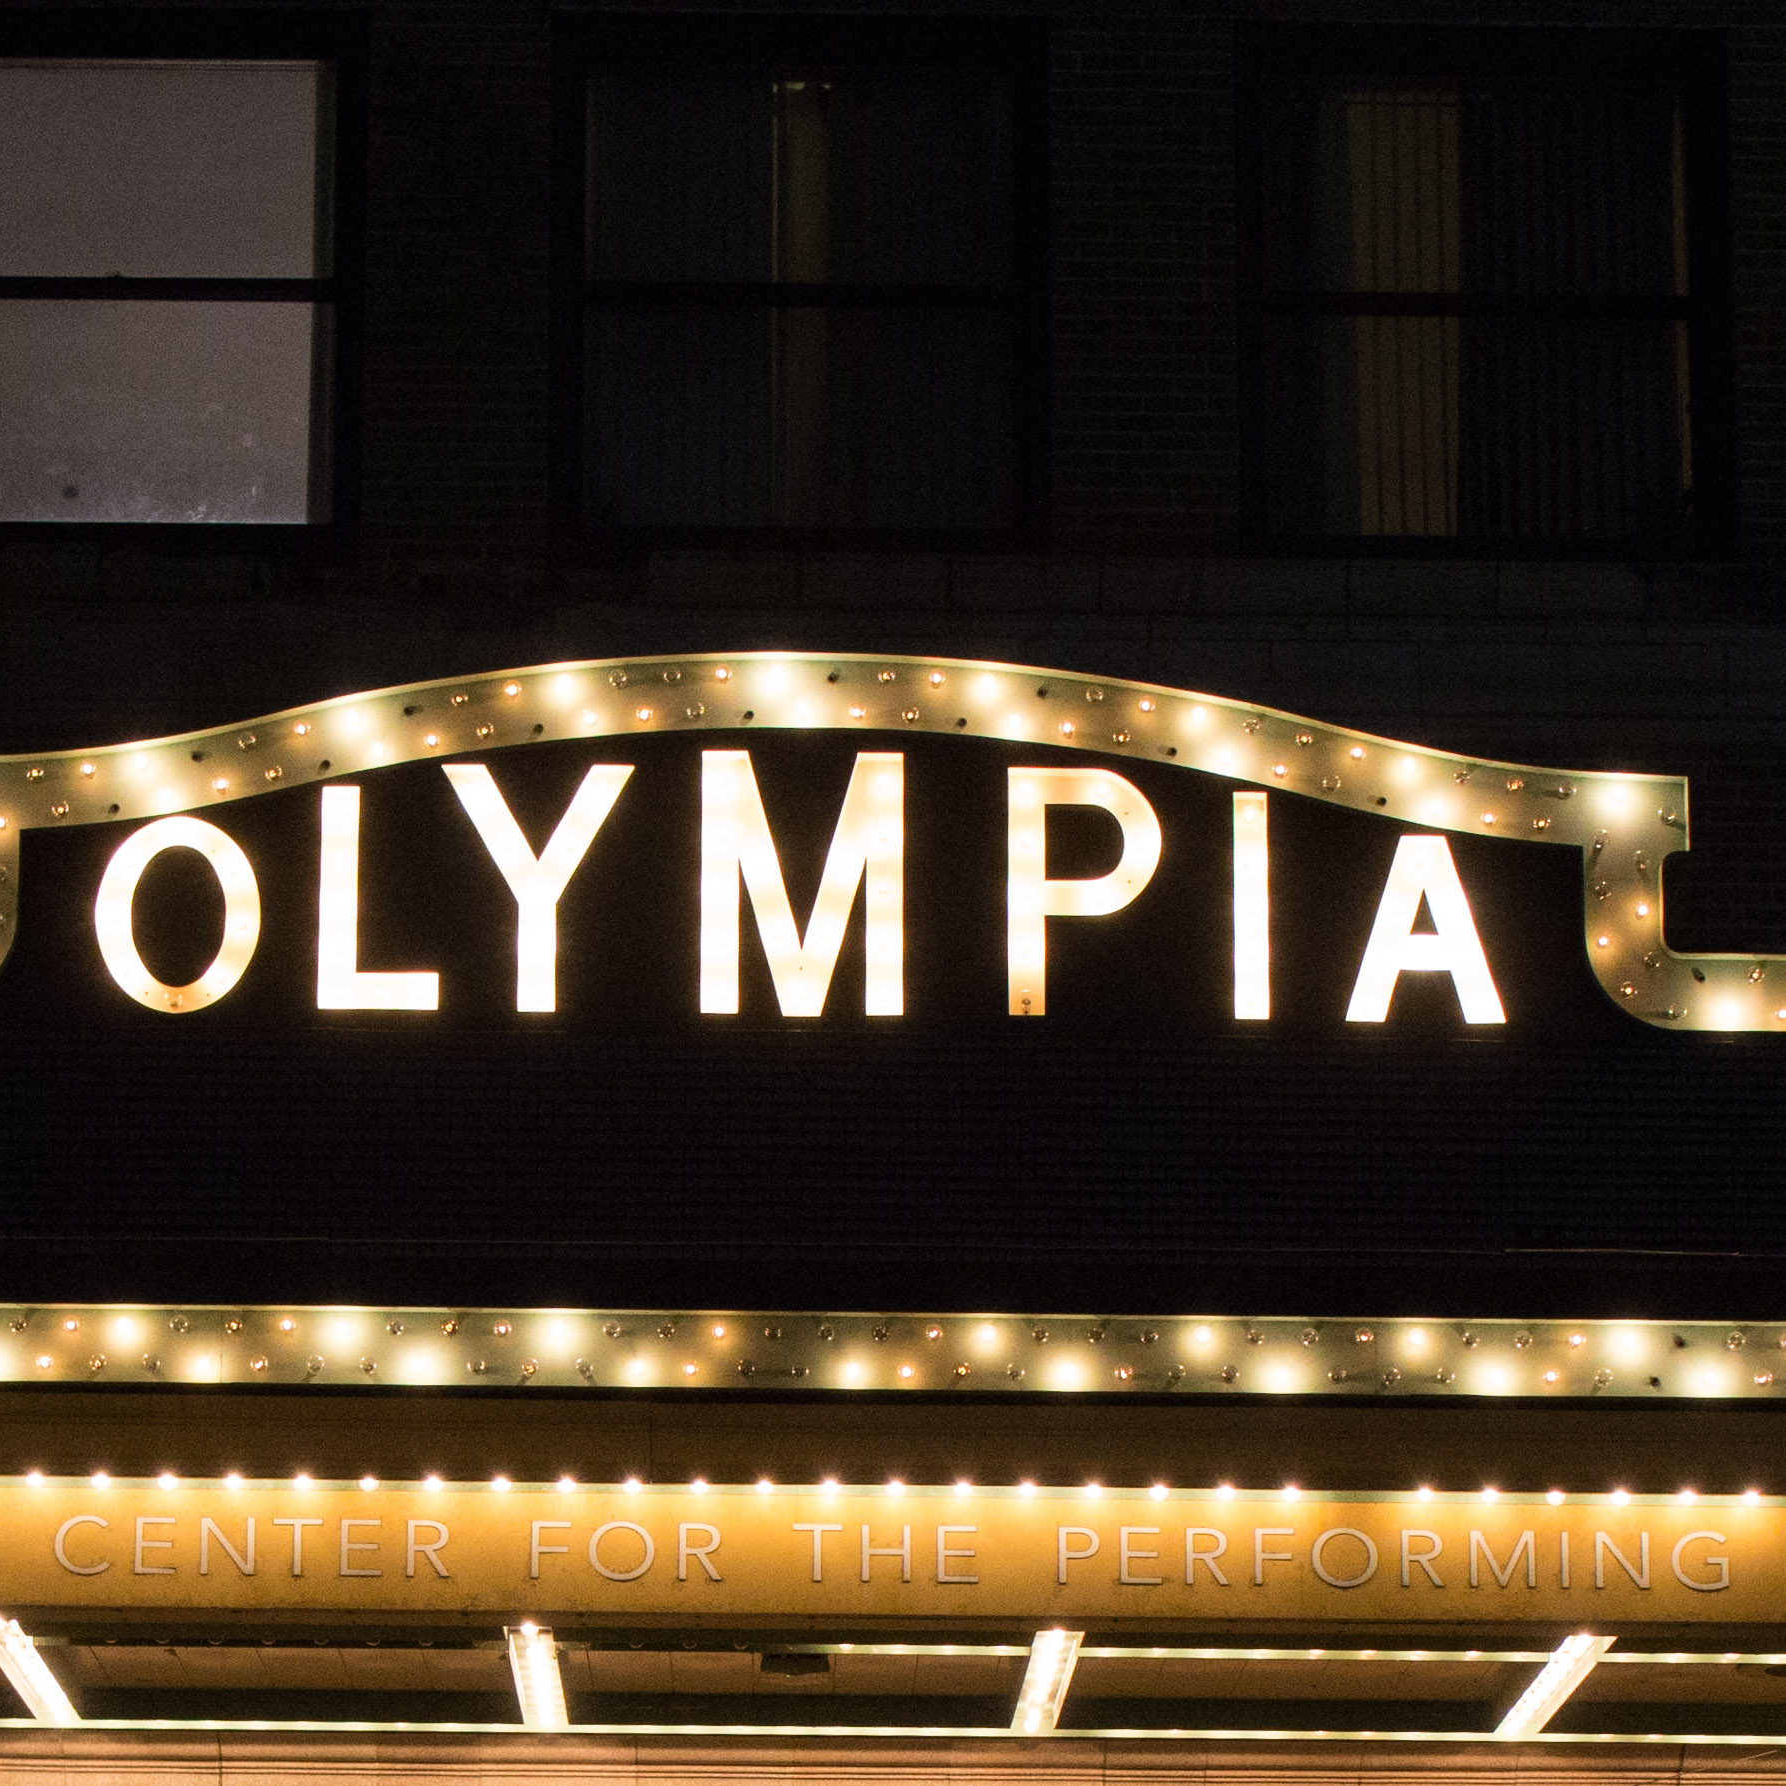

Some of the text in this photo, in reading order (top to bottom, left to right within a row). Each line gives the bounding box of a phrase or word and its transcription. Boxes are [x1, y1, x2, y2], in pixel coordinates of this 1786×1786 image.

[93, 748, 1507, 1026] OLYMPIA
[54, 1513, 451, 1579] CENTER
[527, 1519, 724, 1583] FOR
[791, 1521, 980, 1586] THE
[1057, 1524, 1731, 1594] PERFORMING
